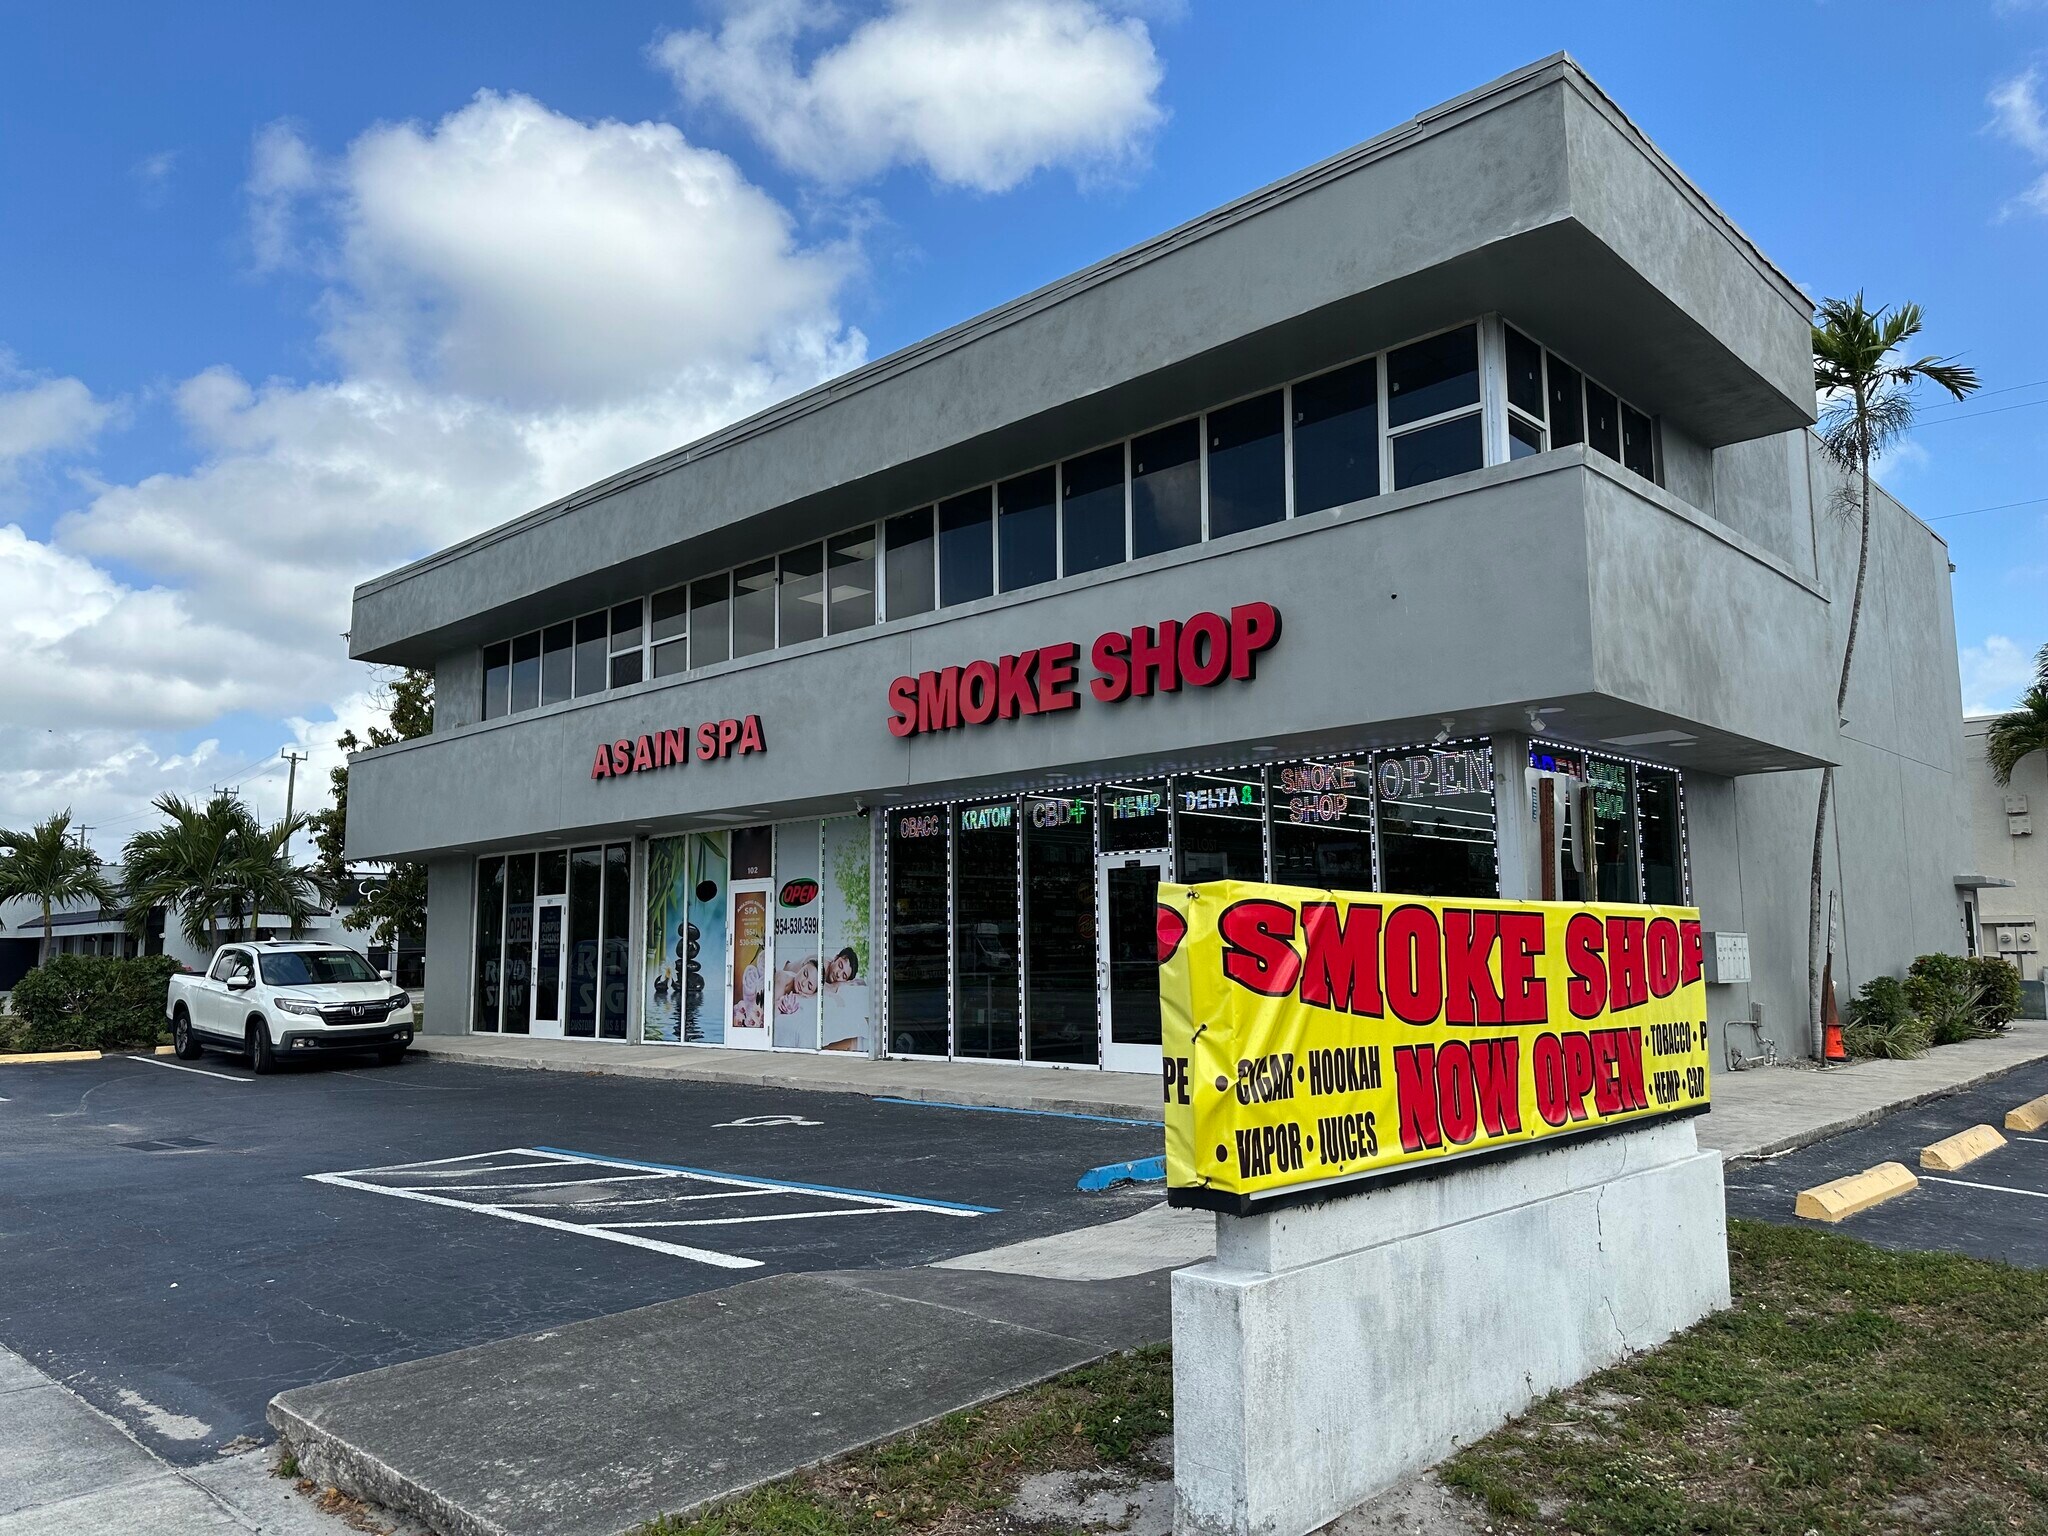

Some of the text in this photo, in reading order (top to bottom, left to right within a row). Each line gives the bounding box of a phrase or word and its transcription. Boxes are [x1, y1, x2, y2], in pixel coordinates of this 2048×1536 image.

[888, 601, 1282, 738] SMOKE SHOP
[591, 714, 767, 779] ASAIN SPA
[1280, 760, 1357, 795] SMOKE
[1380, 748, 1491, 800] OPEN
[1113, 793, 1161, 819] HEMP
[1186, 787, 1239, 810] DELTA
[1289, 794, 1348, 823] SHOP
[961, 806, 1011, 831] KRATOM
[747, 866, 758, 875] 102
[744, 906, 758, 915] SPA
[783, 886, 817, 903] OPEN
[485, 959, 526, 984] RPID
[1218, 898, 1548, 1027] SMOKE
[1566, 912, 1703, 1020] SHOP
[486, 985, 524, 1007] SINS
[1650, 1021, 1691, 1056] TOBACCO
[1235, 1045, 1382, 1106] CIGAR HOOKAH
[1393, 1026, 1649, 1155] NOW OPEN
[1653, 1066, 1705, 1104] HEMP CBD
[1235, 1111, 1379, 1179] VAPOR JUICES
